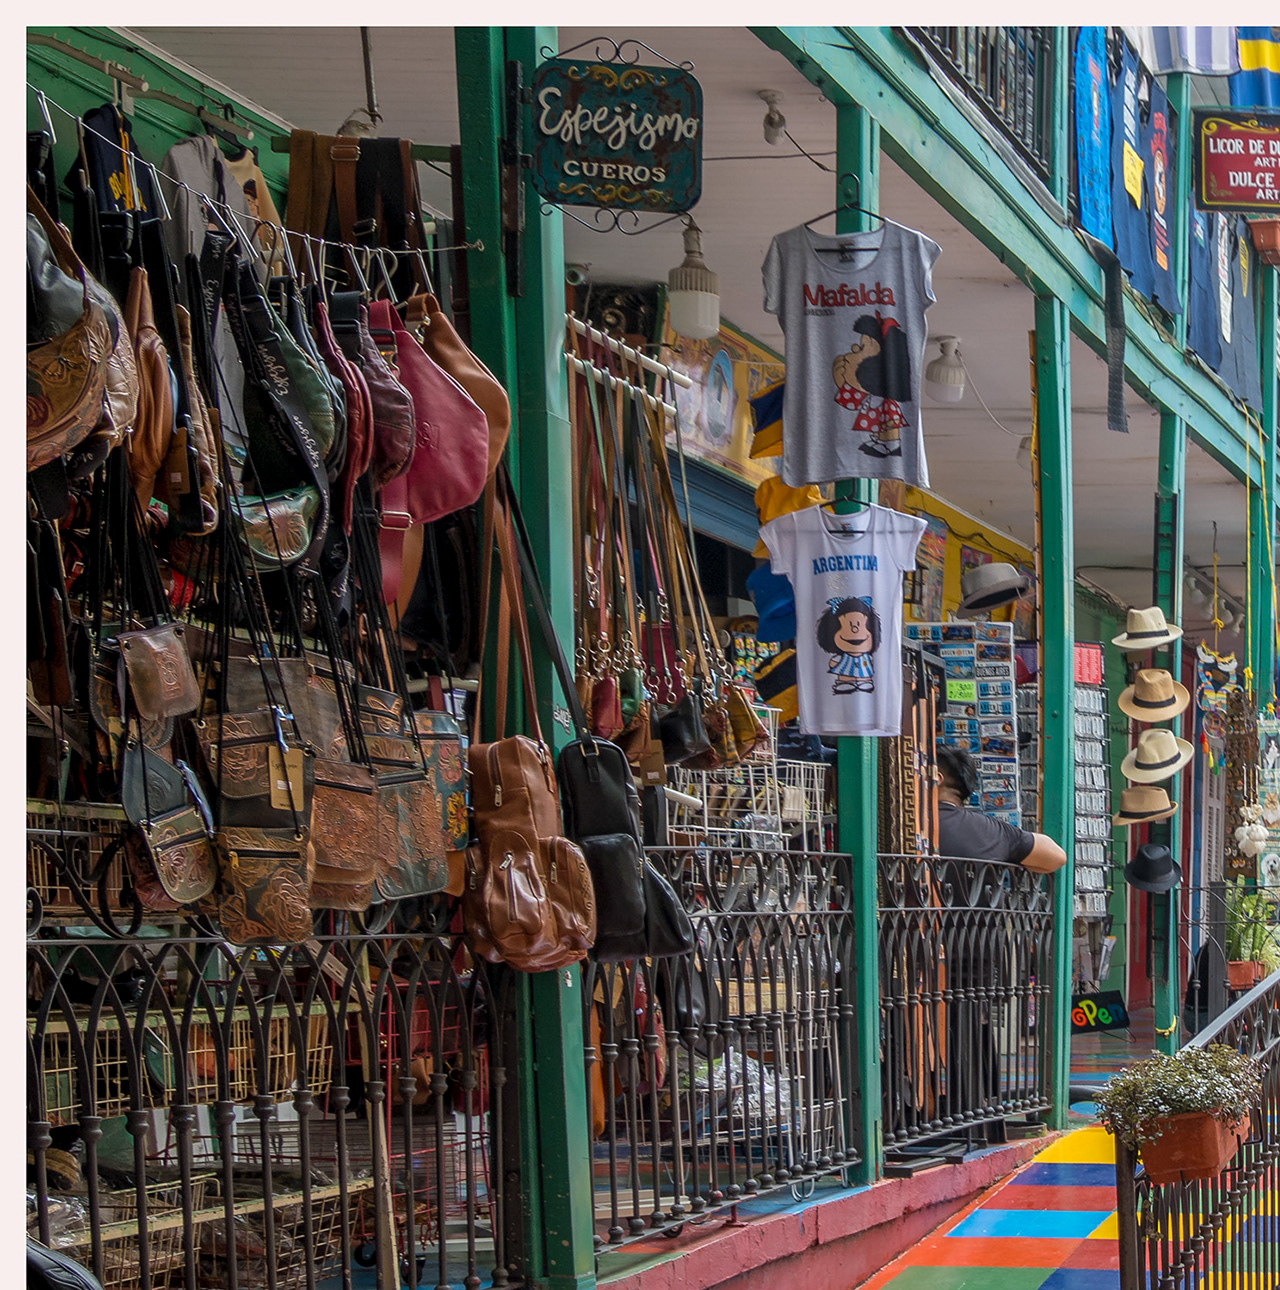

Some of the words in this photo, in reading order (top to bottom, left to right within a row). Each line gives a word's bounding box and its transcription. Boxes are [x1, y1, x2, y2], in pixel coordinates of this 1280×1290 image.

[537, 86, 700, 150] Espejismo
[1209, 137, 1244, 154] LICOR
[1248, 139, 1265, 155] DE
[563, 160, 667, 185] CUEROS
[1228, 171, 1275, 188] DULCE
[803, 282, 896, 308] Mafalda
[812, 554, 878, 576] ARGENTINA
